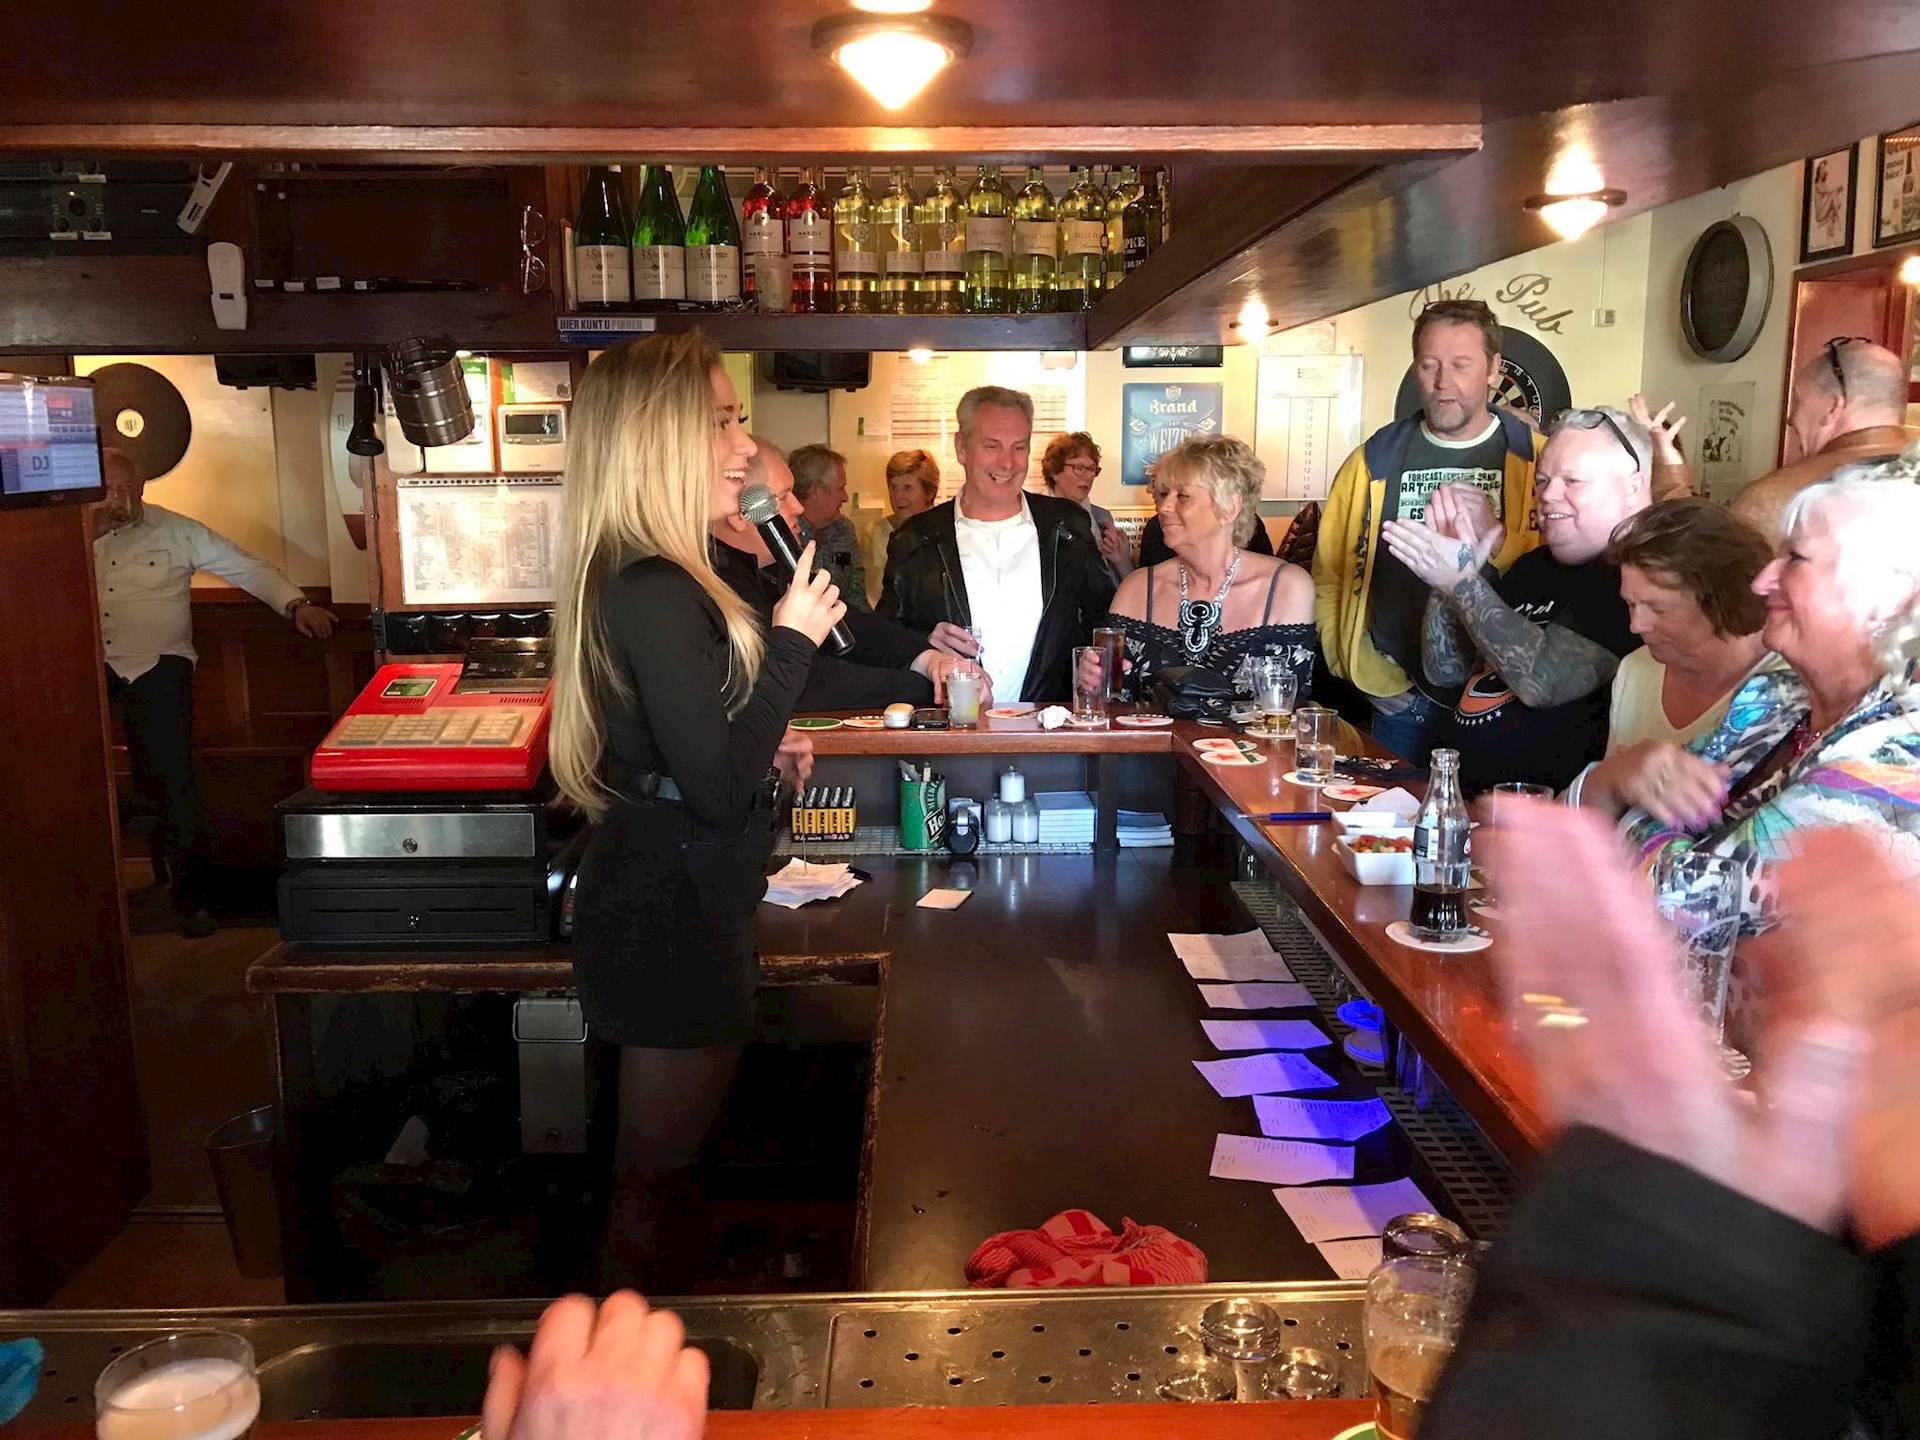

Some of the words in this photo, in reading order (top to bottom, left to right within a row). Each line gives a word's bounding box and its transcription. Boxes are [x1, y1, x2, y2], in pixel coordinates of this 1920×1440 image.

[1495, 273, 1574, 335] Pub
[560, 319, 579, 330] HIER
[580, 319, 603, 330] KUNT
[604, 319, 610, 330] U
[1149, 399, 1198, 415] Brand
[1149, 428, 1193, 454] WEIZ
[32, 456, 50, 471] DJ
[1408, 472, 1442, 482] FORECAST
